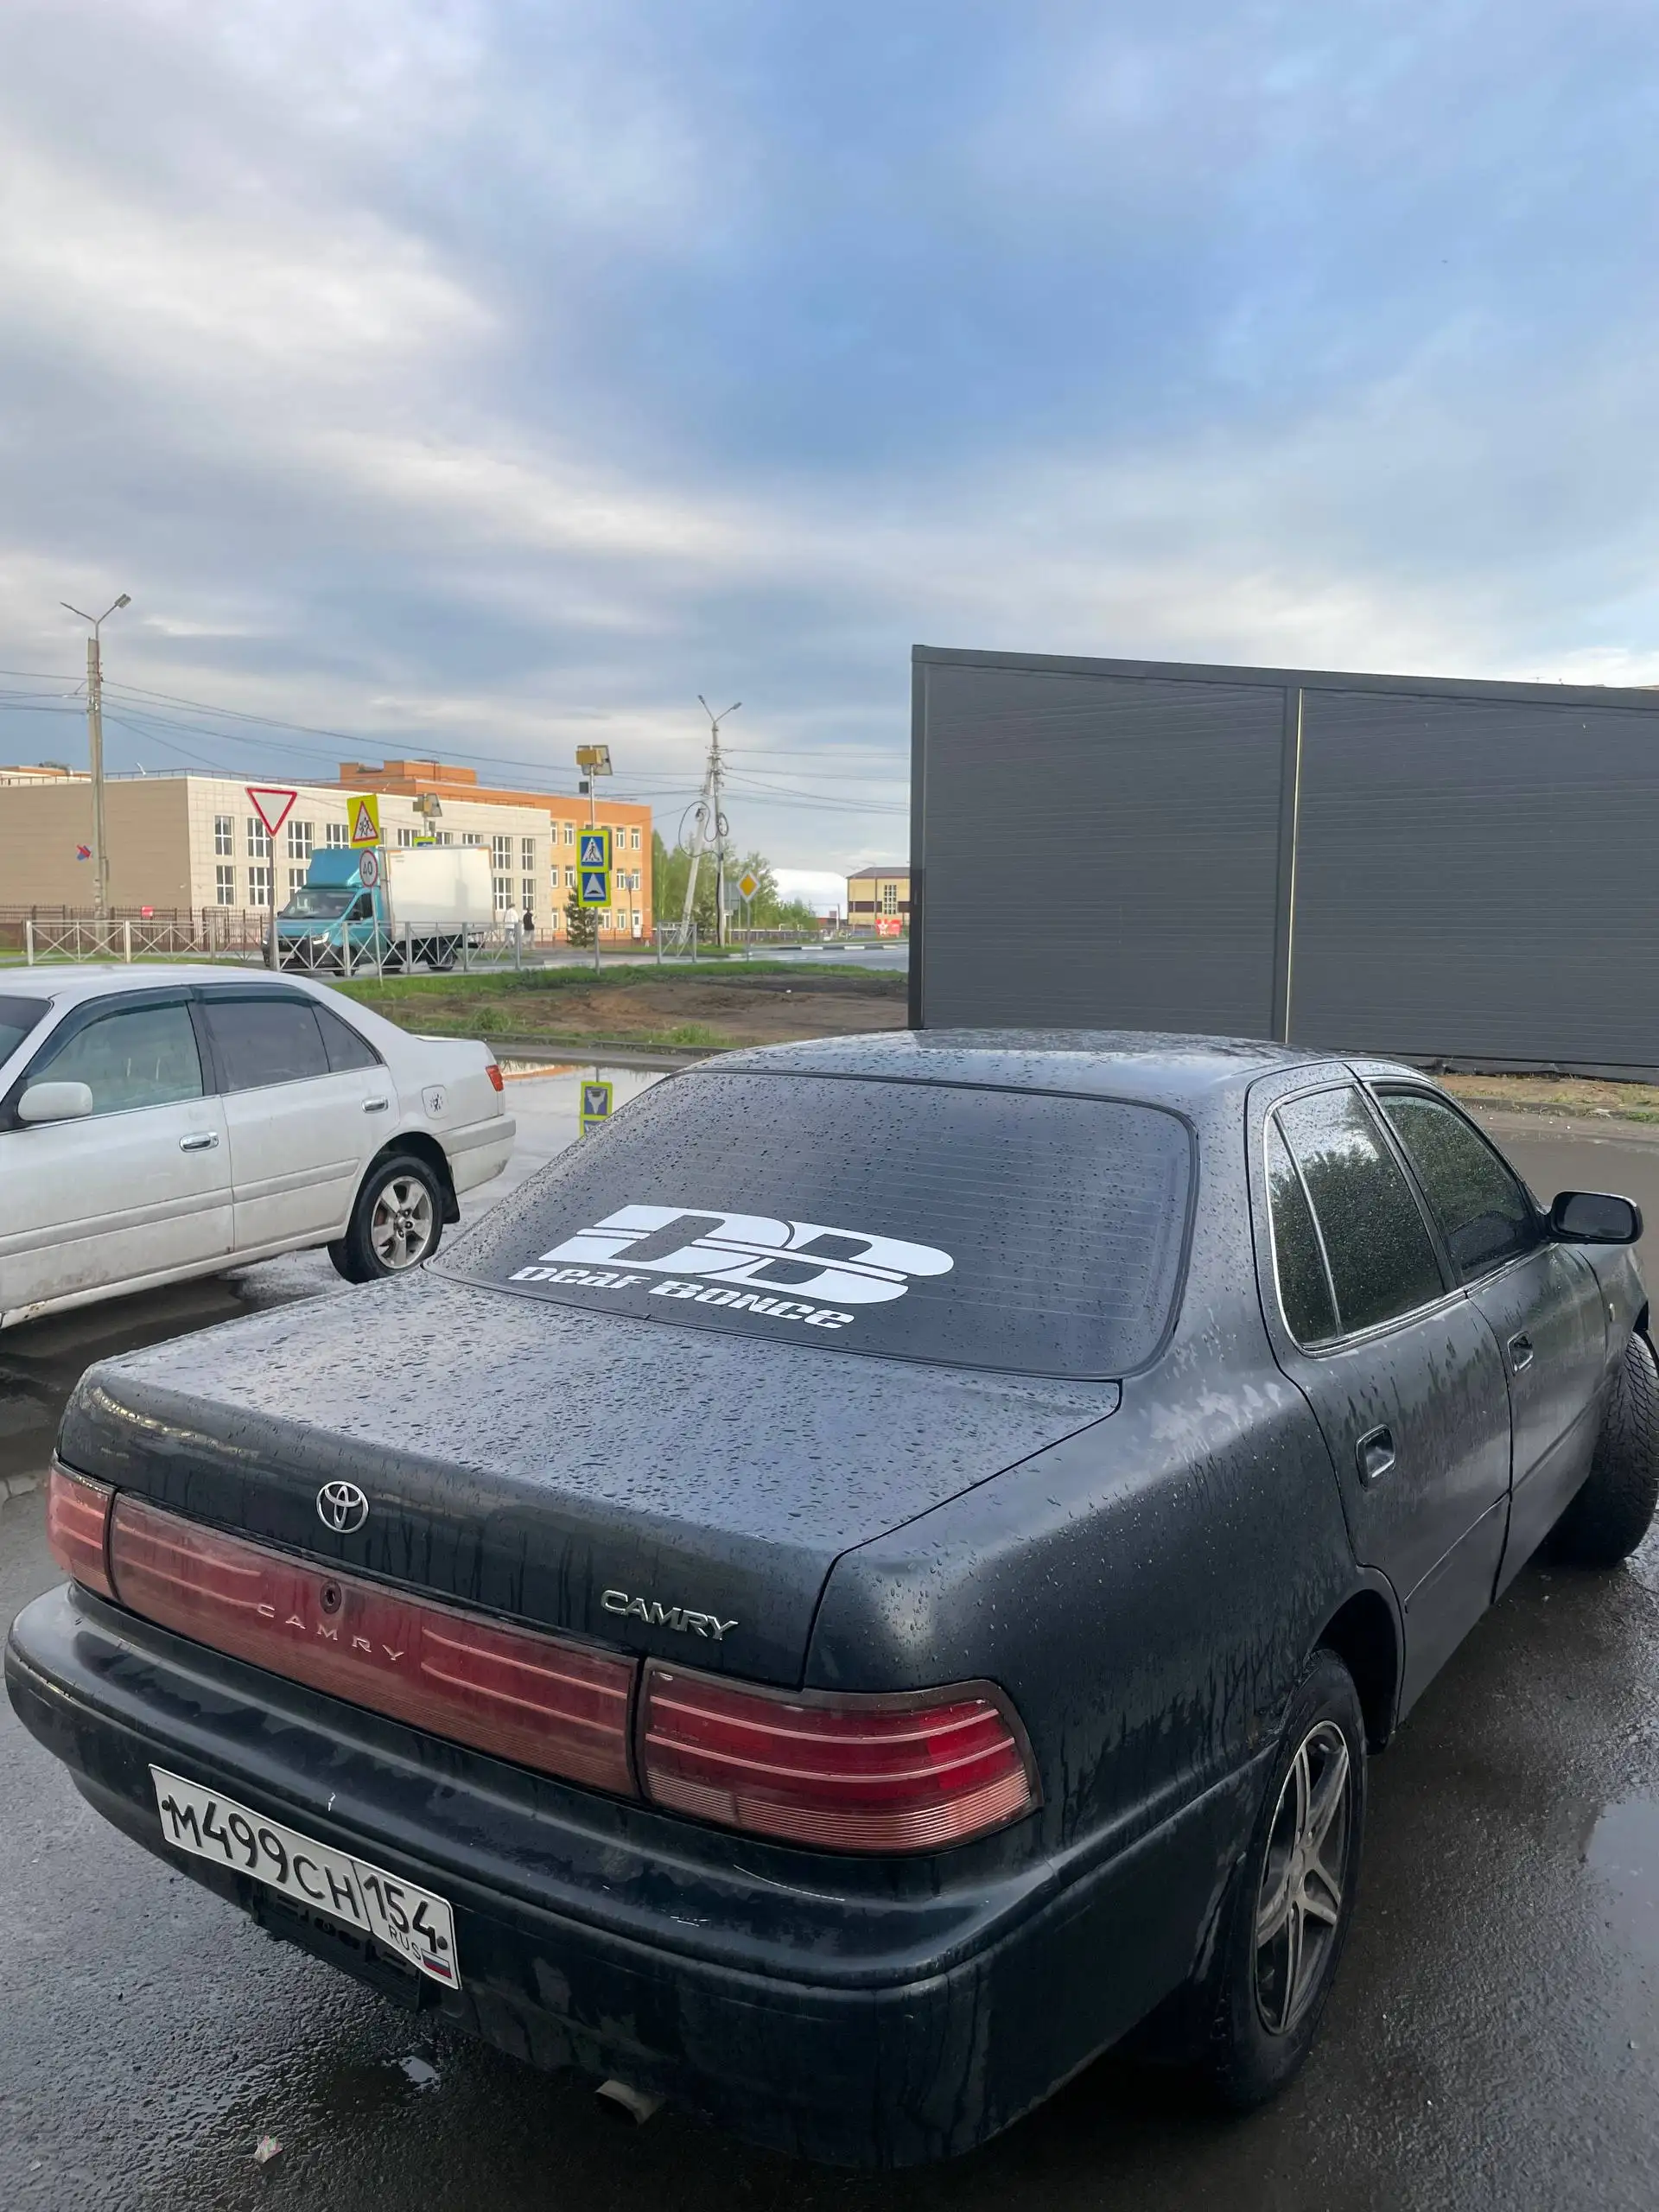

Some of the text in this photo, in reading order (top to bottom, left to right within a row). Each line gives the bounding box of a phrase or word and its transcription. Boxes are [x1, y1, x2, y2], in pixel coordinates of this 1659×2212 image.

[363, 861, 373, 877] 40
[256, 1603, 404, 1662] CAMRY
[601, 1589, 739, 1641] CAMRY
[388, 1923, 423, 1961] RUS
